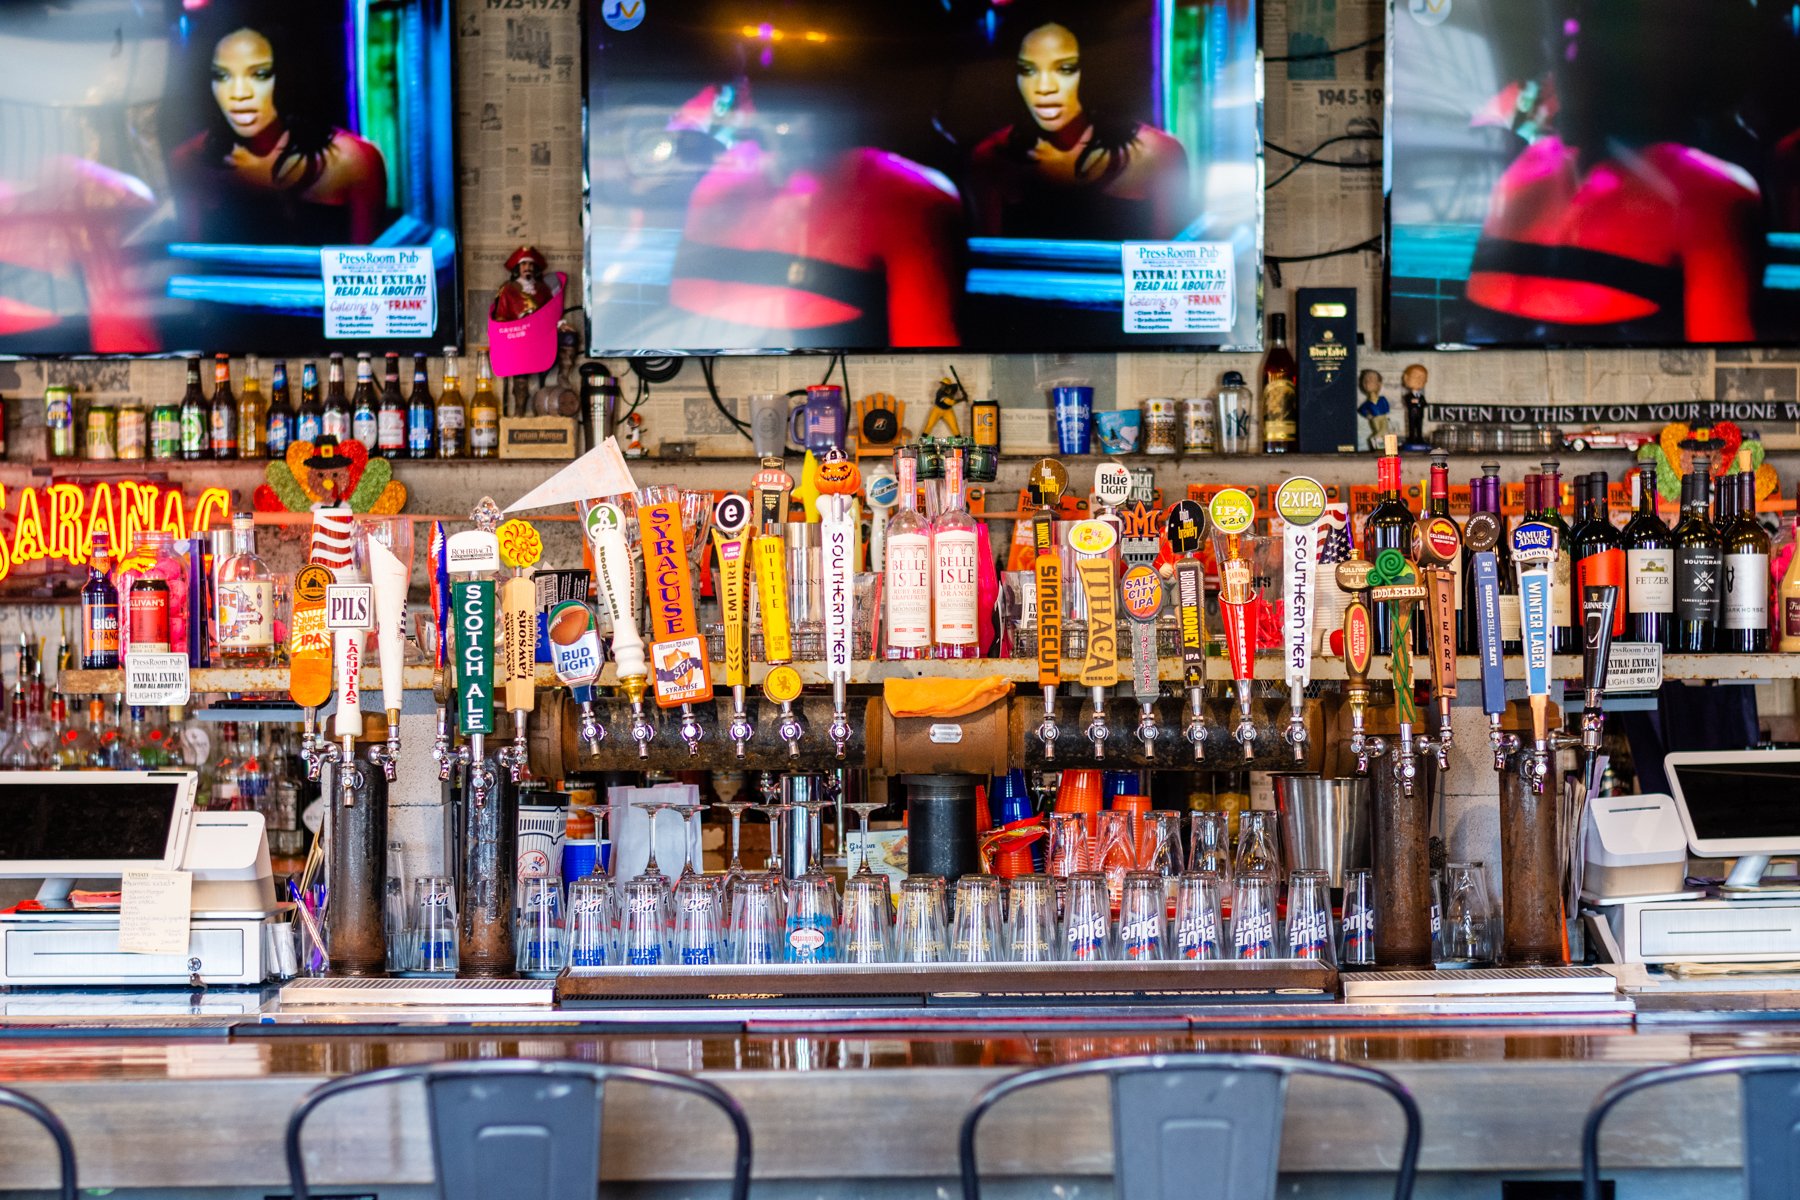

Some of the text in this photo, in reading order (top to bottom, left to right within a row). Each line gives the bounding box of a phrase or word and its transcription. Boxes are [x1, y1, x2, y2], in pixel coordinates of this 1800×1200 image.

[1318, 88, 1383, 105] 1945-19
[339, 250, 419, 264] PressRoom Pub
[1139, 246, 1219, 259] PressRoom Pub
[332, 274, 427, 285] EXTRA! EXTRA!
[1132, 269, 1226, 280] EXTRA! EXTRA!
[335, 285, 426, 296] READ ALL ABOUT IT!
[1134, 280, 1225, 291] READ ALL ABOUT IT!
[330, 300, 368, 316] Catering
[370, 299, 381, 314] by
[1129, 295, 1168, 310] Catering
[1169, 294, 1179, 309] by
[507, 331, 526, 339] CLUB
[1429, 403, 1777, 422] LISTEN TO THIS TV ON YOUR PHONE
[757, 473, 786, 483] 1911
[1100, 473, 1128, 486] Blue
[1101, 485, 1128, 495] LIGHT
[1281, 491, 1323, 508] 2XIPA
[724, 503, 738, 522] e
[1215, 506, 1249, 517] IPA
[1486, 516, 1496, 530] ARTS
[1177, 525, 1198, 540] brewery
[1515, 529, 1551, 541] SAMUEL
[451, 545, 493, 555] ROHRBACH
[1518, 537, 1549, 548] ADAMS
[599, 545, 613, 592] BROOKLYN
[892, 559, 927, 571] BELLE
[940, 556, 974, 567] BELLE
[650, 507, 685, 635] SYRACUSE
[940, 568, 975, 584] ISLE
[892, 572, 927, 587] ISLE
[1125, 574, 1156, 591] SALT
[1635, 576, 1670, 585] FETZER
[726, 559, 738, 623] EMPIRE
[743, 560, 751, 623] EMPIRE
[831, 531, 845, 666] SOUTHERN TIER
[1128, 585, 1156, 600] CITY
[331, 596, 367, 621] PILS
[1133, 596, 1154, 610] IPA
[1180, 570, 1200, 649] BURNING MONEY
[1292, 534, 1308, 669] SOUTHERN TIER
[1583, 601, 1610, 610] GUINNESS
[93, 618, 118, 630] Blue
[298, 614, 326, 625] JUICE
[298, 622, 326, 633] BOMB
[1041, 565, 1059, 677] SINGLECUT
[1082, 565, 1114, 674] ITHACA
[1485, 584, 1498, 667] LIFE IN THE CLOUDS
[1527, 581, 1546, 669] WINTER LAGER
[464, 584, 484, 676] SCOTCH
[1441, 593, 1452, 672] SIERRA
[301, 633, 323, 646] IPA
[504, 611, 512, 682] Lawson's
[516, 609, 527, 681] Lawson's
[561, 646, 591, 662] BUD
[1185, 653, 1200, 661] IPA
[1609, 646, 1656, 654] ressRoom Pub
[132, 658, 168, 666] PressRoom
[558, 656, 597, 674] LIGHT
[674, 660, 695, 680] SPA
[1608, 658, 1657, 668] XTRA! EXTRA!
[132, 672, 184, 683] EXTRA! EXTRA!
[345, 638, 359, 705] LAGUNITAS
[665, 682, 698, 694] SYRACUSE
[1607, 676, 1656, 686] LIGHTS $6.00
[130, 692, 163, 700] FLIGHTS
[669, 690, 697, 701] PALE ALE
[466, 683, 485, 730] ALE
[1121, 914, 1159, 942] Blue
[1180, 911, 1216, 933] LIGHT
[1235, 910, 1272, 931] LIGHT
[1292, 910, 1327, 930] LIGHT
[1067, 914, 1106, 943] Blue
[1234, 925, 1271, 947] BLUE
[1289, 925, 1327, 948] BLUE
[1178, 926, 1217, 948] BLUE
